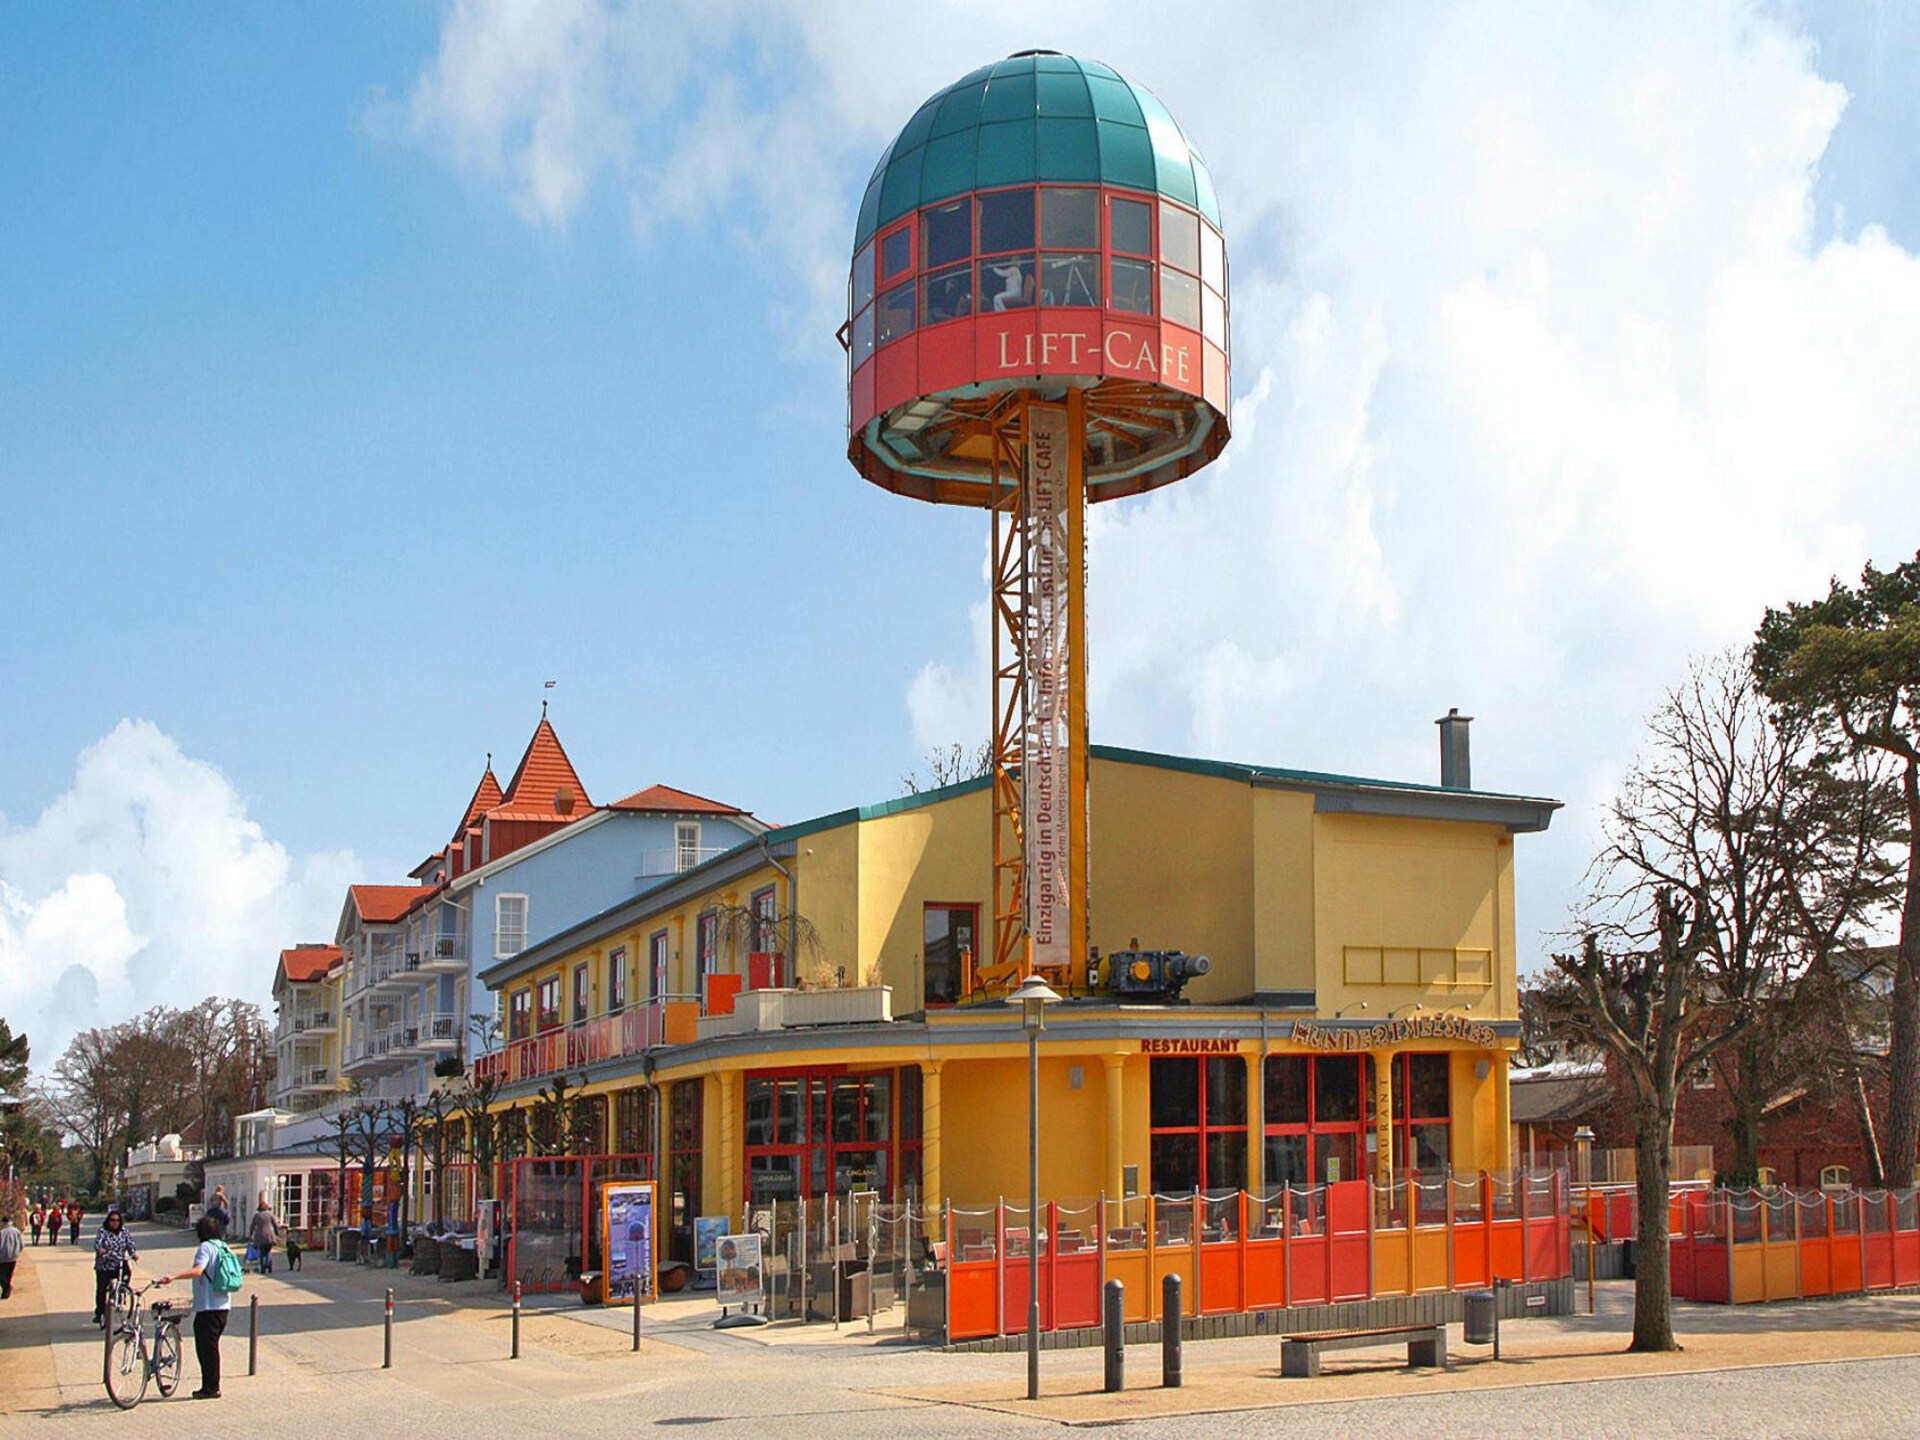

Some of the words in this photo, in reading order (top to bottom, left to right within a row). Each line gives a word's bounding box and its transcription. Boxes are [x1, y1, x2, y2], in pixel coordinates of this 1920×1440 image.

[1036, 829, 1052, 846] in
[1056, 835, 1066, 858] dem
[1036, 851, 1055, 945] Einzigartig
[1141, 1039, 1240, 1052] RESTAURANT
